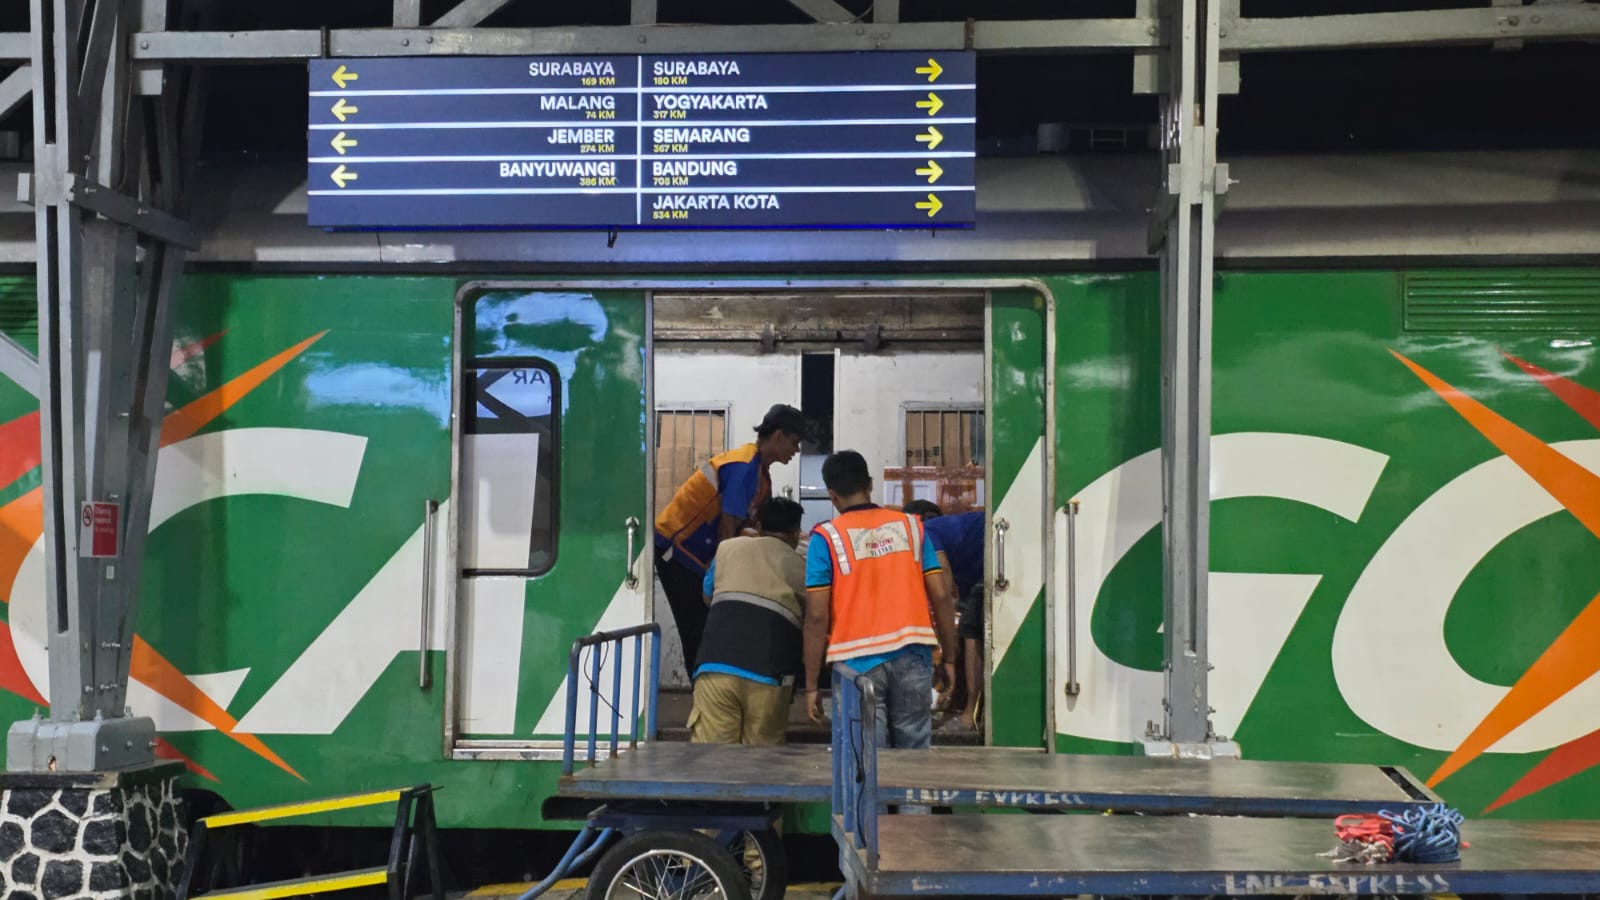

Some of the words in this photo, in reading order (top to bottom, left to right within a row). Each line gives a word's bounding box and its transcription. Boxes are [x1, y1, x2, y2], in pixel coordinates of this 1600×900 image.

[529, 61, 615, 77] SURABAYA
[653, 60, 740, 76] SURABAYA
[581, 77, 597, 86] 169
[598, 77, 615, 85] KM
[671, 76, 688, 85] KM
[540, 95, 615, 110] MALANG
[653, 94, 768, 110] YOGYAKARTA
[585, 111, 597, 119] 74
[598, 110, 615, 119] KM
[652, 110, 669, 119] 317
[669, 110, 687, 119] KM
[547, 128, 615, 144] JEMBER
[653, 128, 751, 143] SEMARANG
[598, 144, 615, 153] KM
[671, 144, 688, 153] KM
[499, 161, 616, 177] BANYUWANGI
[652, 161, 738, 176] BANDUNG
[598, 177, 615, 186] KM
[671, 176, 689, 186] KM
[652, 194, 731, 210] JAKARTA
[733, 194, 780, 210] KOTA
[671, 210, 689, 219] KM
